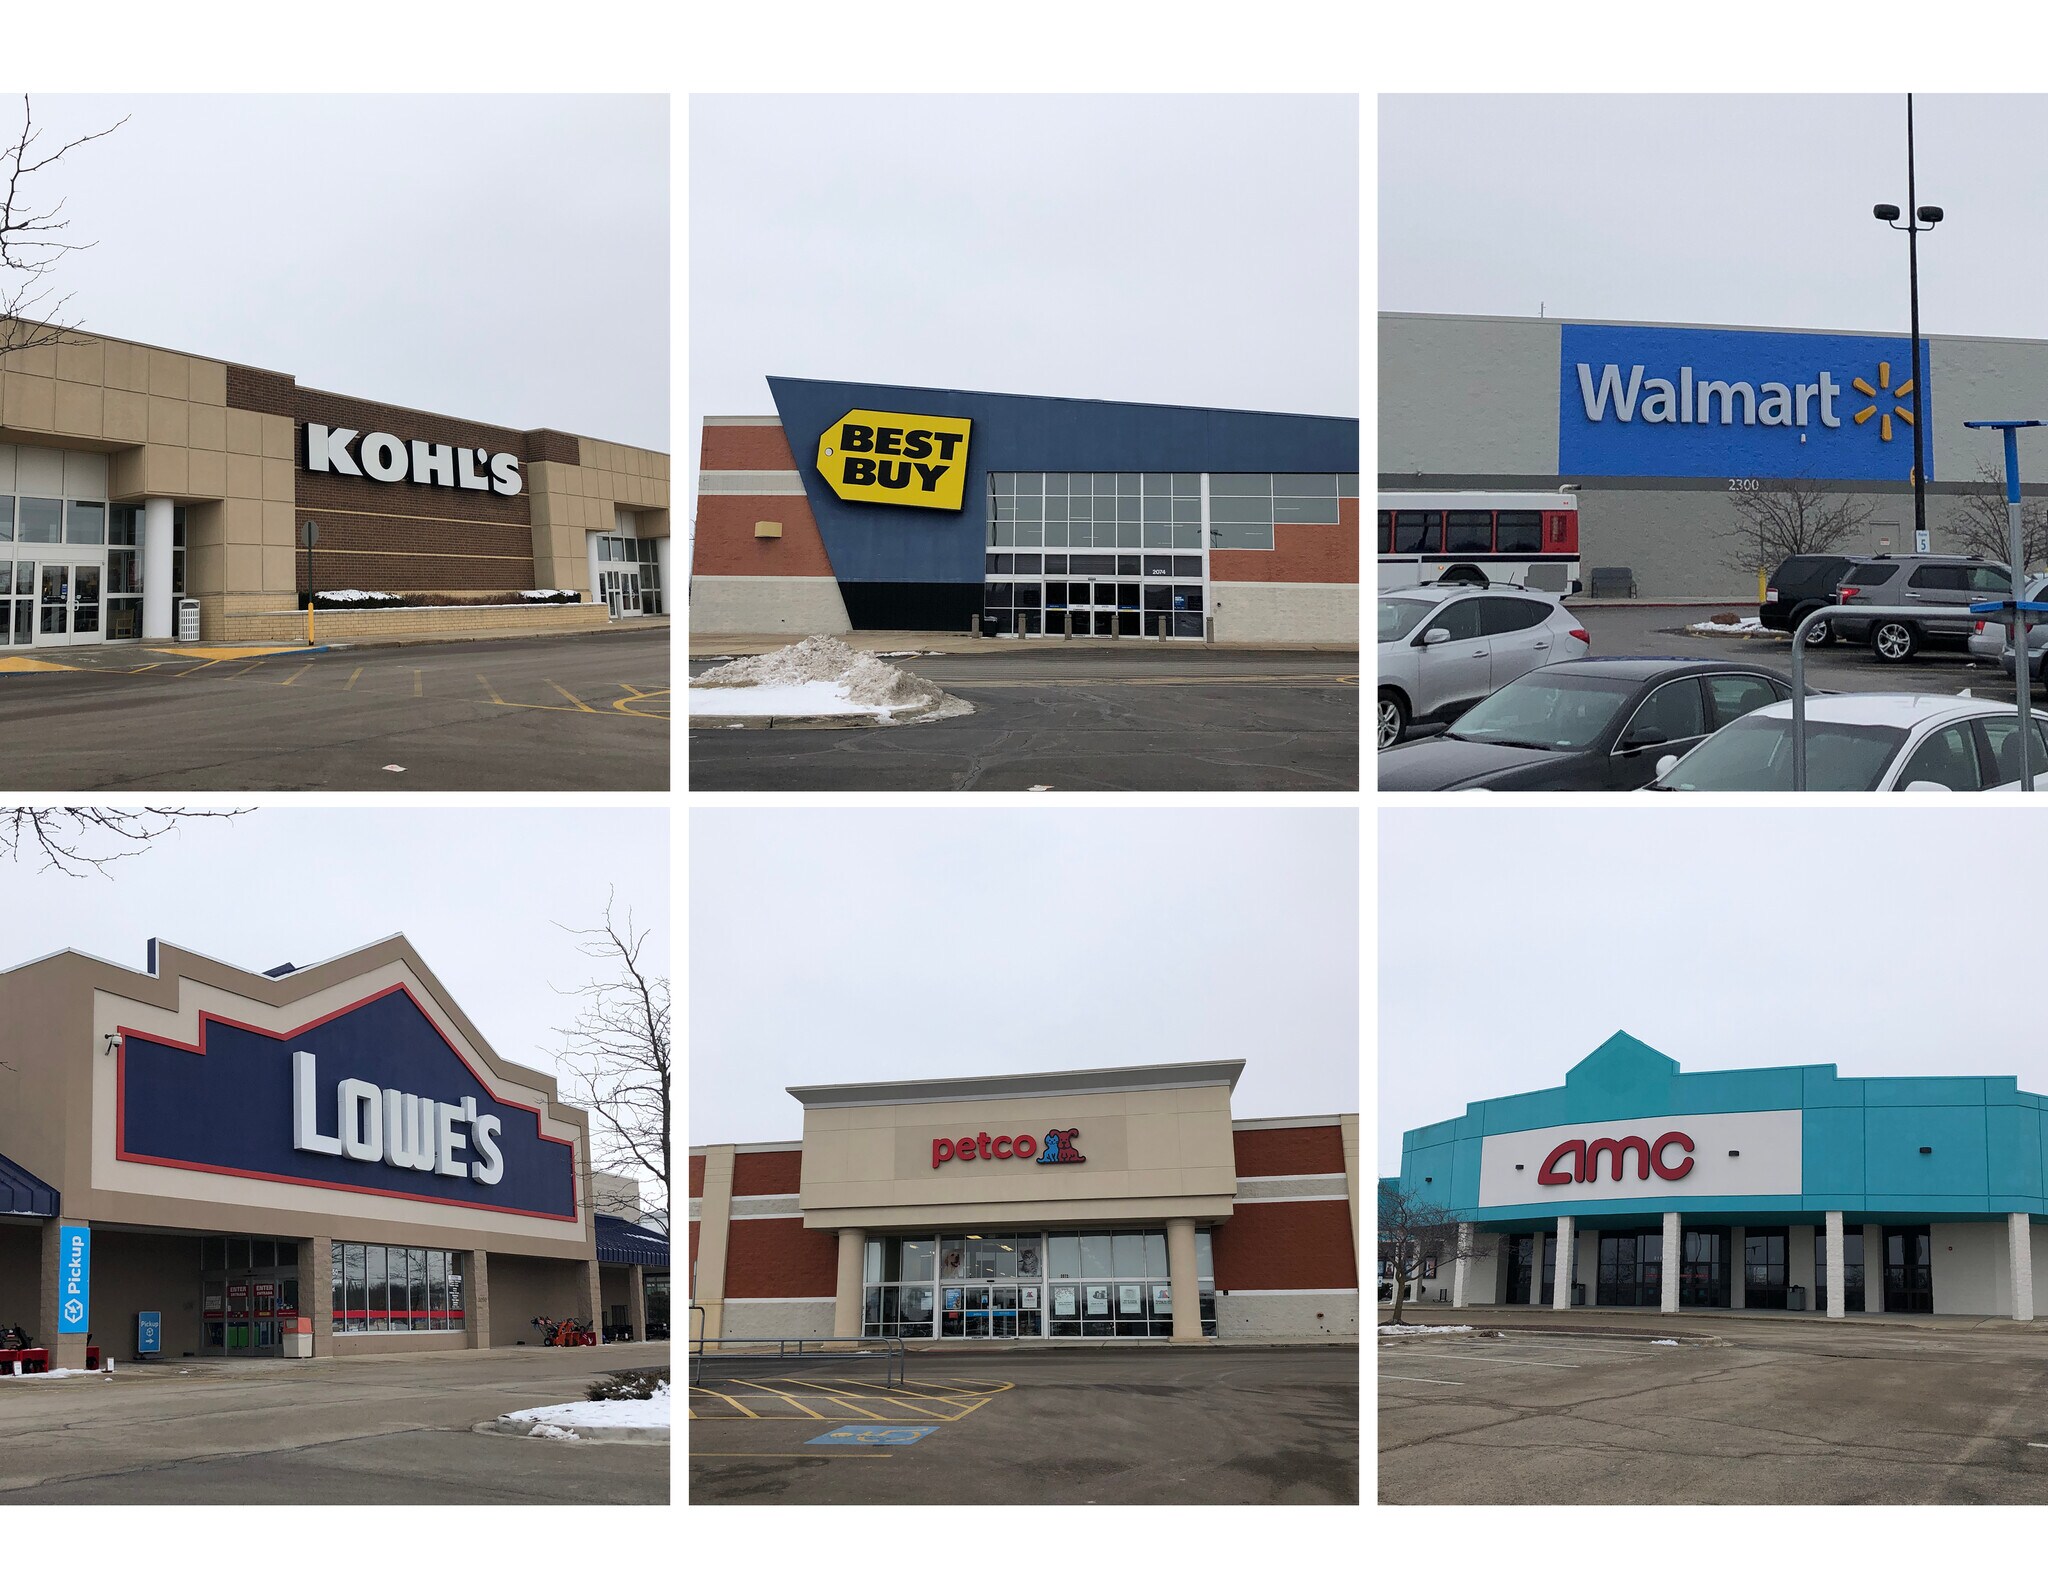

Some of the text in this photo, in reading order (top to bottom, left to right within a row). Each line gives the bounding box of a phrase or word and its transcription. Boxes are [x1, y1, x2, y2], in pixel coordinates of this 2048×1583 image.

[1577, 363, 1841, 429] Walmart
[306, 422, 523, 497] KOHL'S
[840, 423, 964, 462] BEST
[843, 456, 950, 493] BUY
[1728, 478, 1760, 491] 2300
[1920, 539, 1927, 550] 5
[292, 1050, 505, 1186] LOWE'S
[931, 1131, 1037, 1169] petco
[67, 1235, 85, 1295] Pickup
[140, 1320, 160, 1328] Pickup
